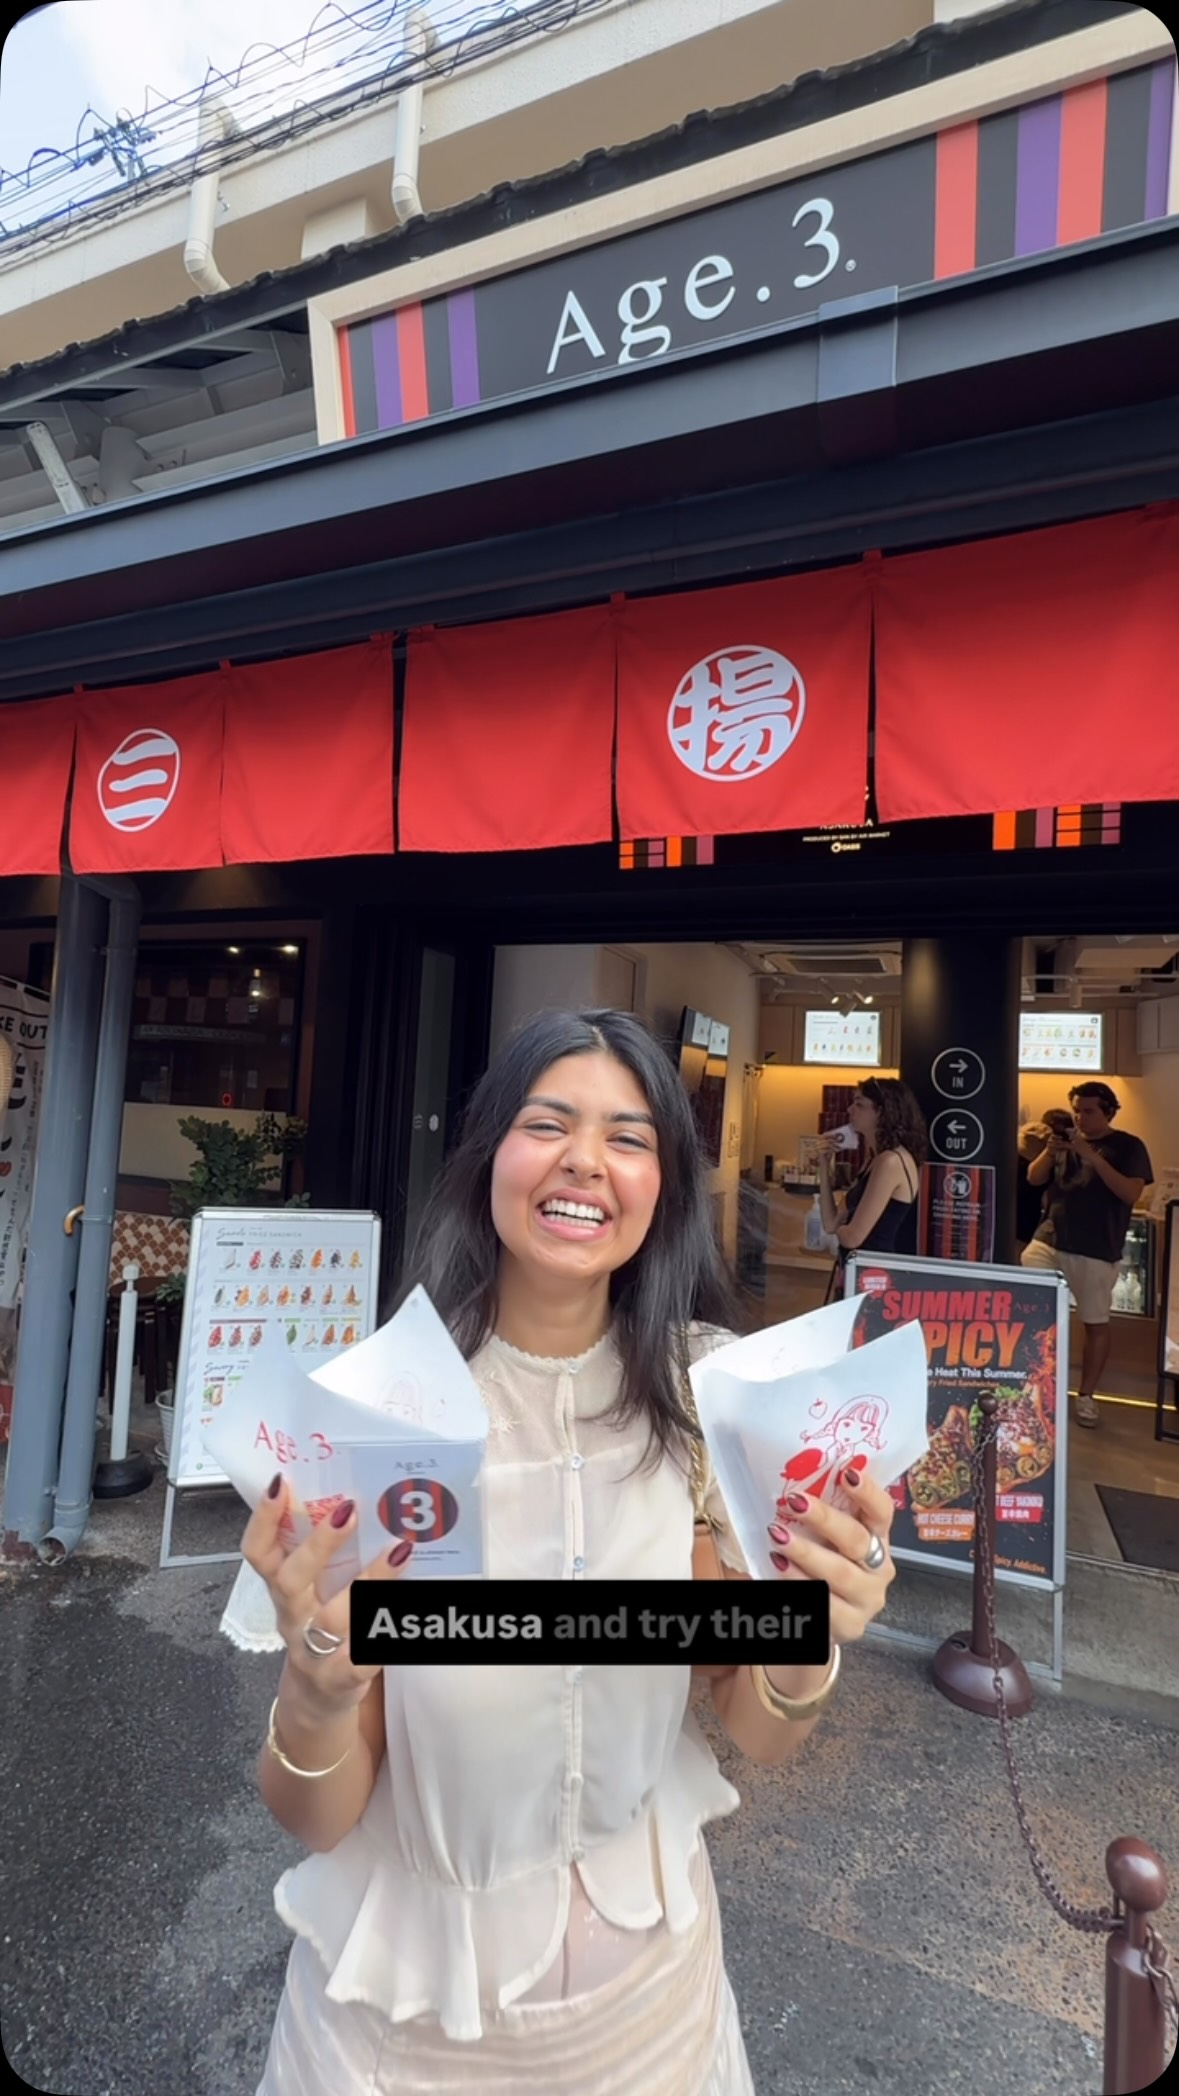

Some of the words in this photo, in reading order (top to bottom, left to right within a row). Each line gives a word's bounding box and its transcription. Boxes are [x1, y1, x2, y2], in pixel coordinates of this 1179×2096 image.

[671, 648, 795, 773] 揚
[952, 1076, 964, 1088] IN
[946, 1137, 968, 1150] OUT
[882, 1290, 1013, 1321] SUMMER
[895, 1321, 1024, 1368] PICY
[934, 1368, 959, 1377] Heat
[960, 1367, 982, 1378] This
[400, 1490, 437, 1532] 3
